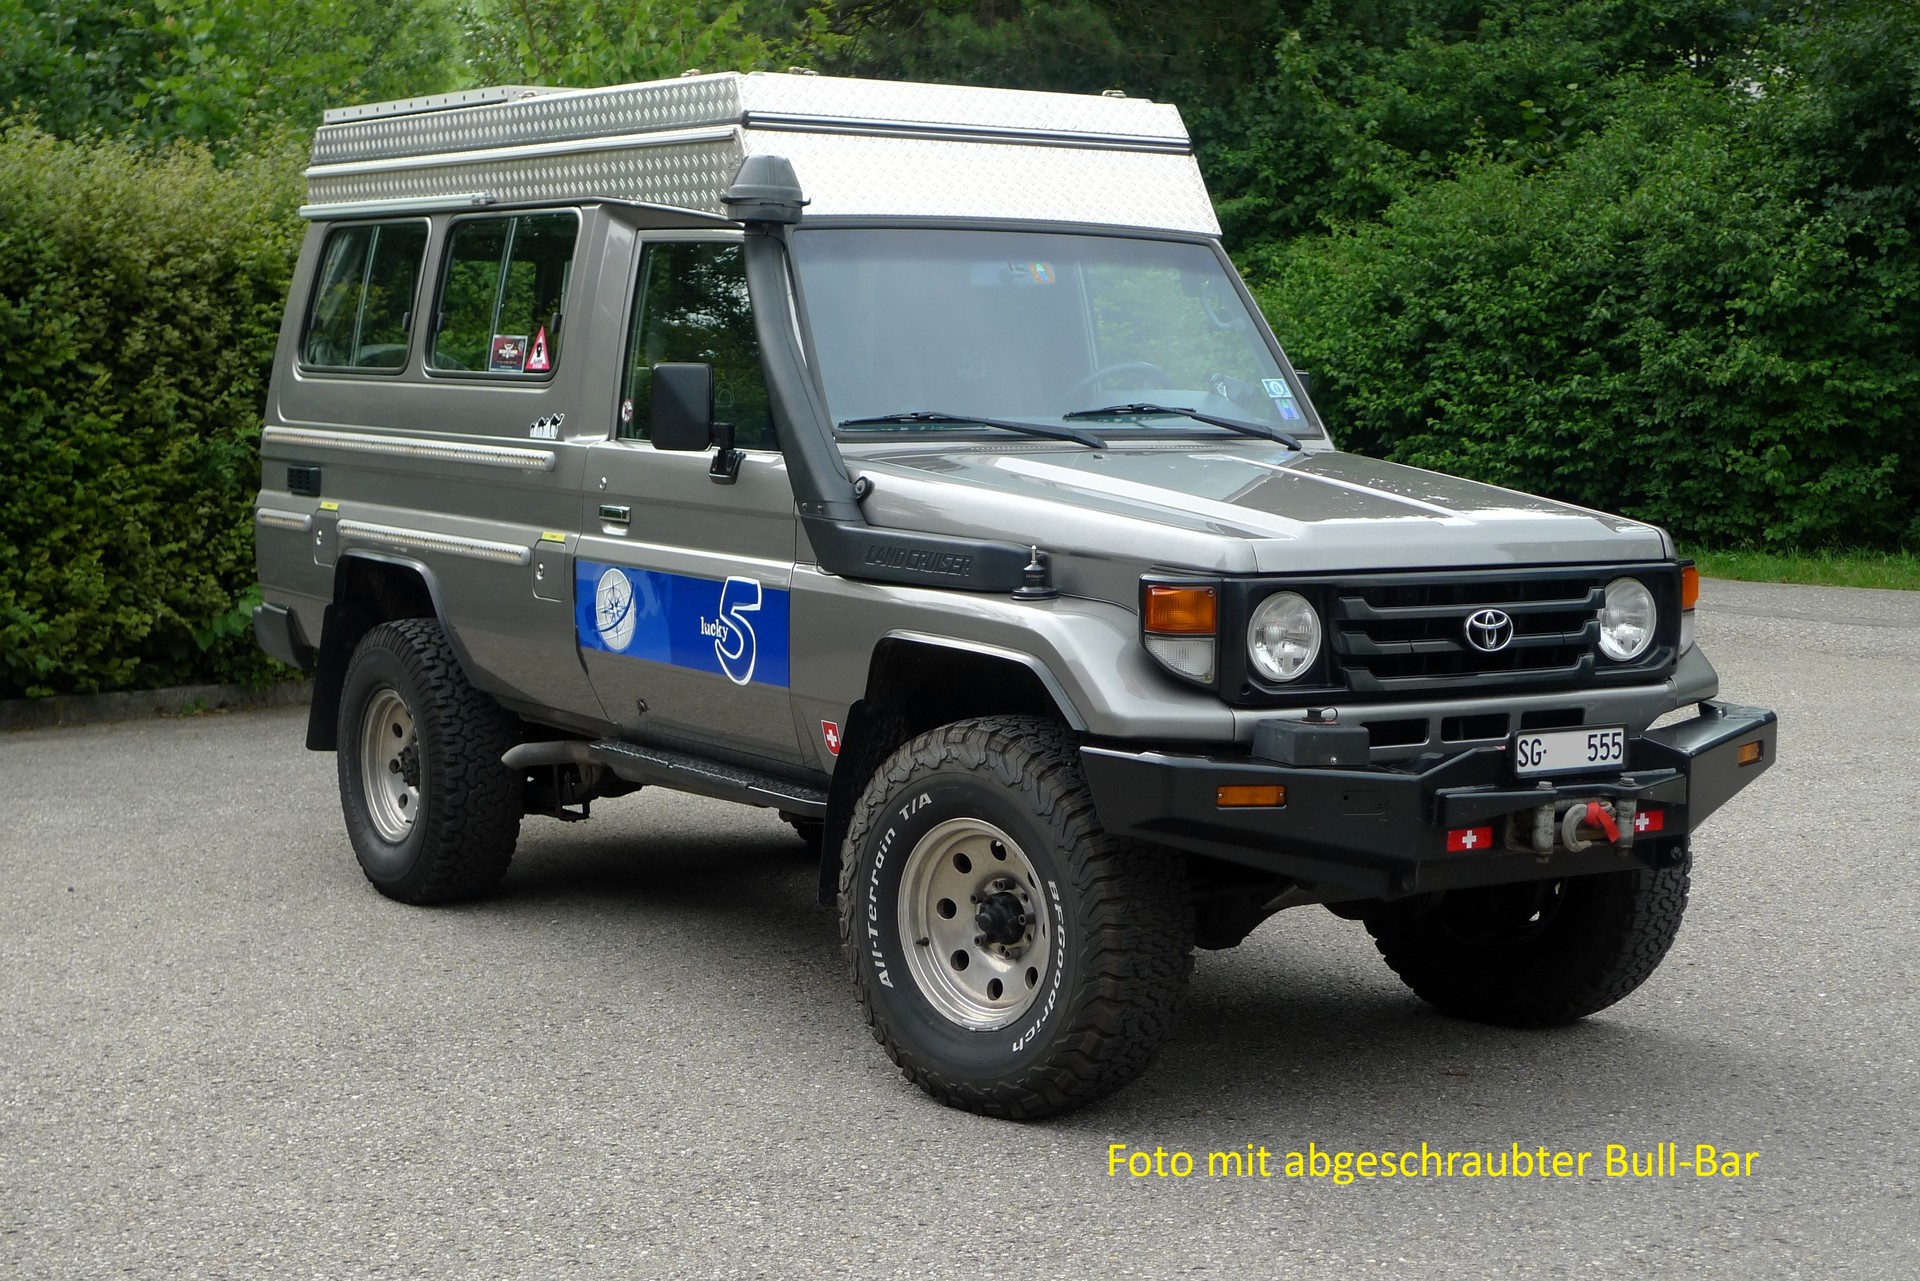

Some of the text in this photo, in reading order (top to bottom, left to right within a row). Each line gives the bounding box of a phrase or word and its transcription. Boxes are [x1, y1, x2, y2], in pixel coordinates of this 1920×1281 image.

[864, 545, 973, 577] LAND CRUISER
[700, 575, 762, 686] lucky 5
[1587, 731, 1622, 762] 555
[867, 792, 933, 989] All-Terrain T/A
[1012, 880, 1067, 1052] BFGoodrich
